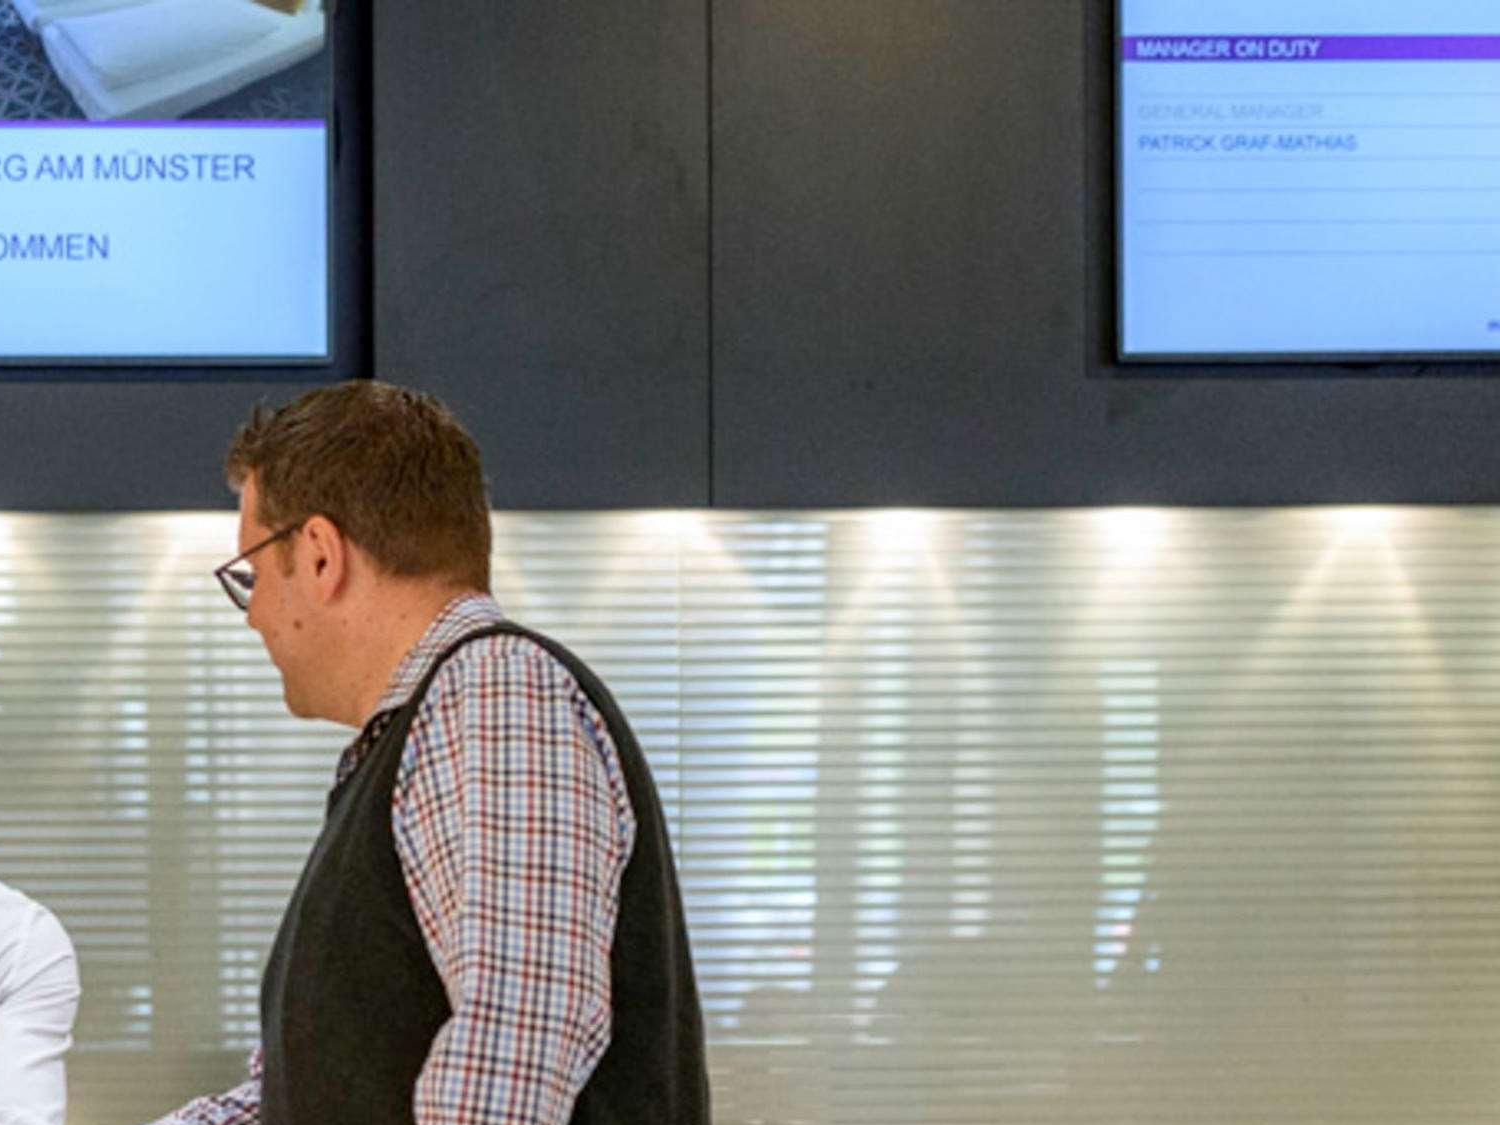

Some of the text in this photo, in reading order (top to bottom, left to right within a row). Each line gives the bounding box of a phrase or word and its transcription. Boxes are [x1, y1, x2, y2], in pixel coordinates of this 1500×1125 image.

[1136, 39, 1321, 58] MANAGER ON DUTY
[1137, 134, 1215, 150] PATRICK
[34, 153, 84, 181] AM
[93, 149, 257, 182] MÜNSTER
